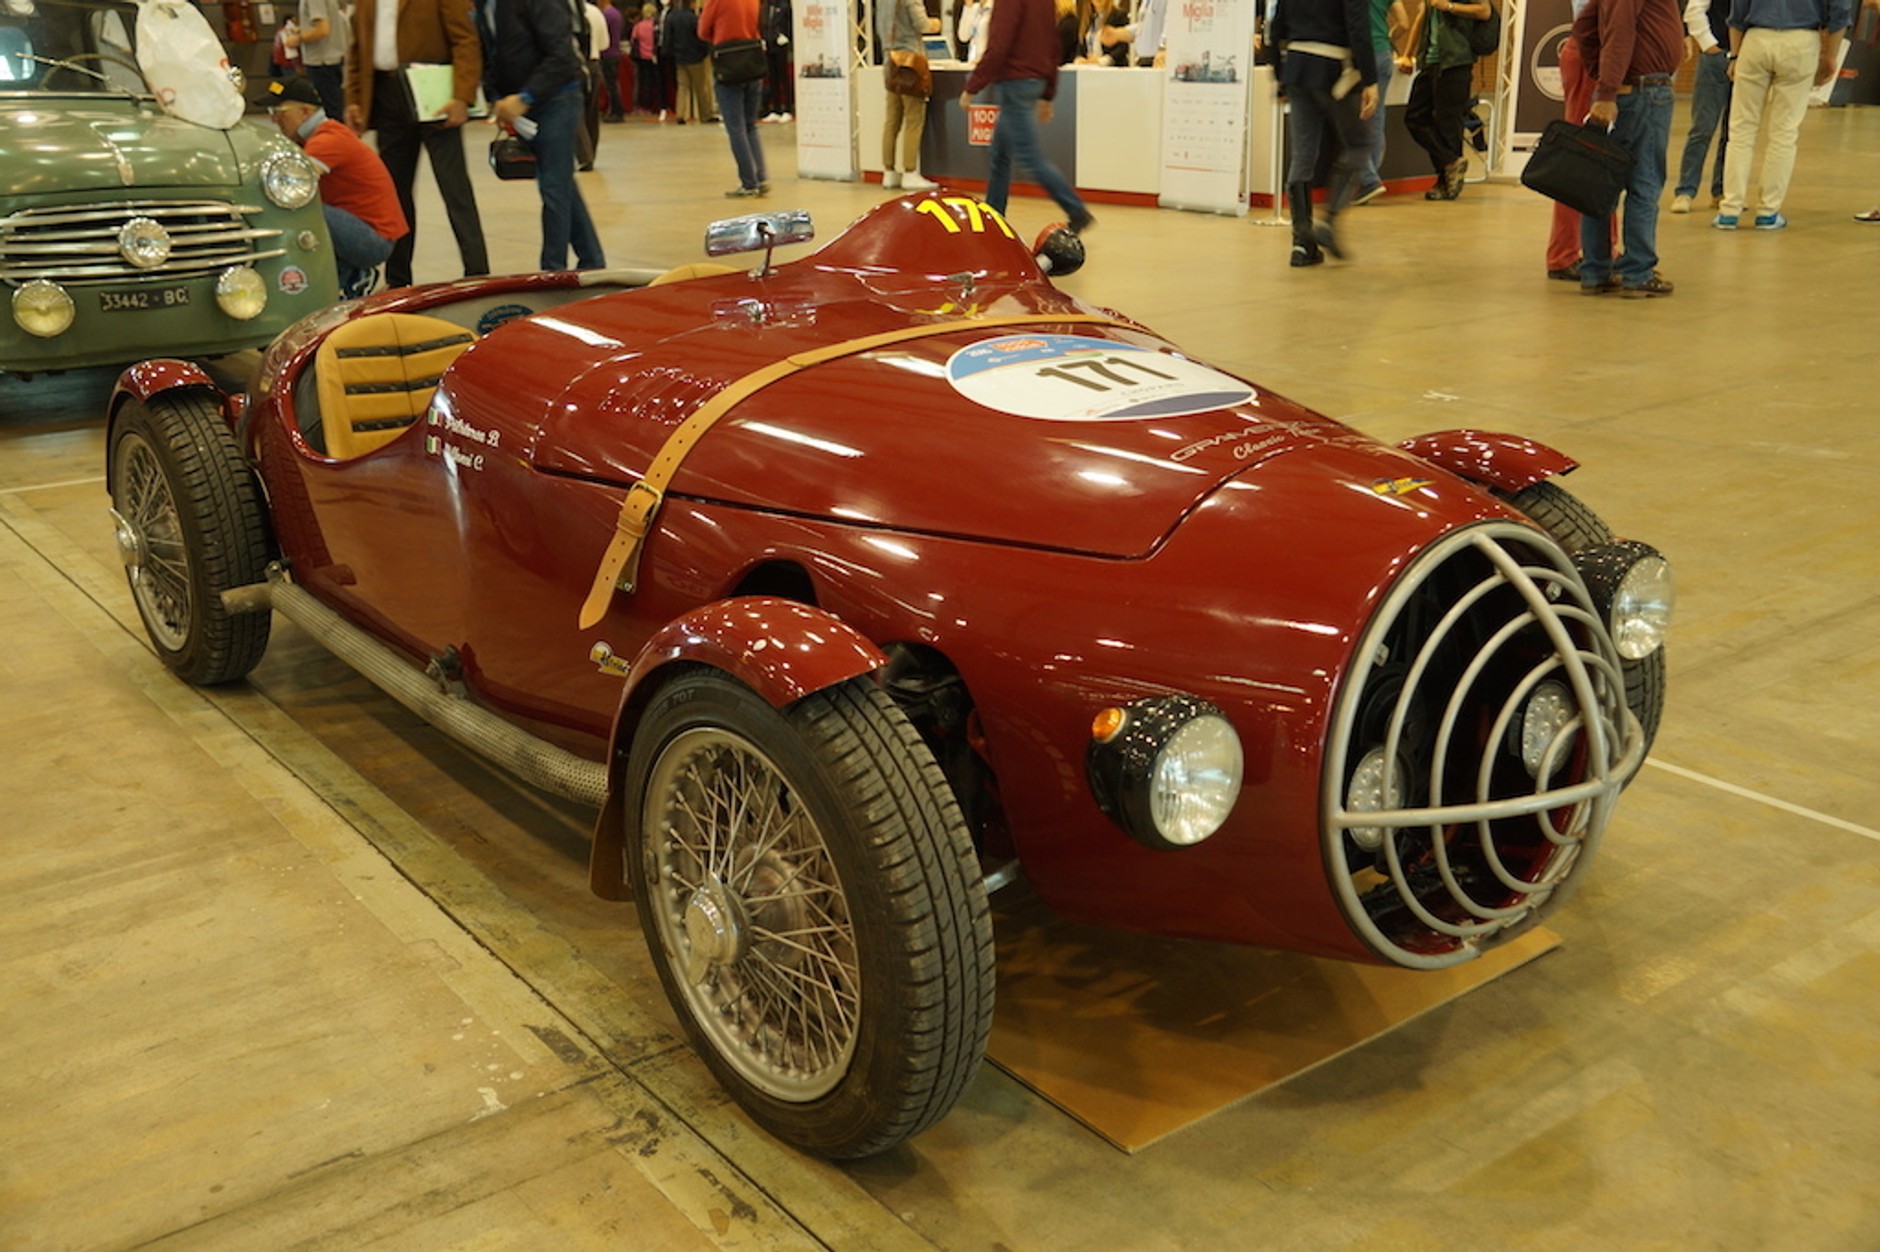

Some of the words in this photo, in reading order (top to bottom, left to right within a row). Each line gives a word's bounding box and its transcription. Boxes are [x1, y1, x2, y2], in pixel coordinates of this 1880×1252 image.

[974, 110, 1000, 124] 100
[915, 197, 1016, 240] 171
[101, 292, 149, 311] 33442
[1035, 356, 1180, 392] 171
[1233, 434, 1286, 460] Classic
